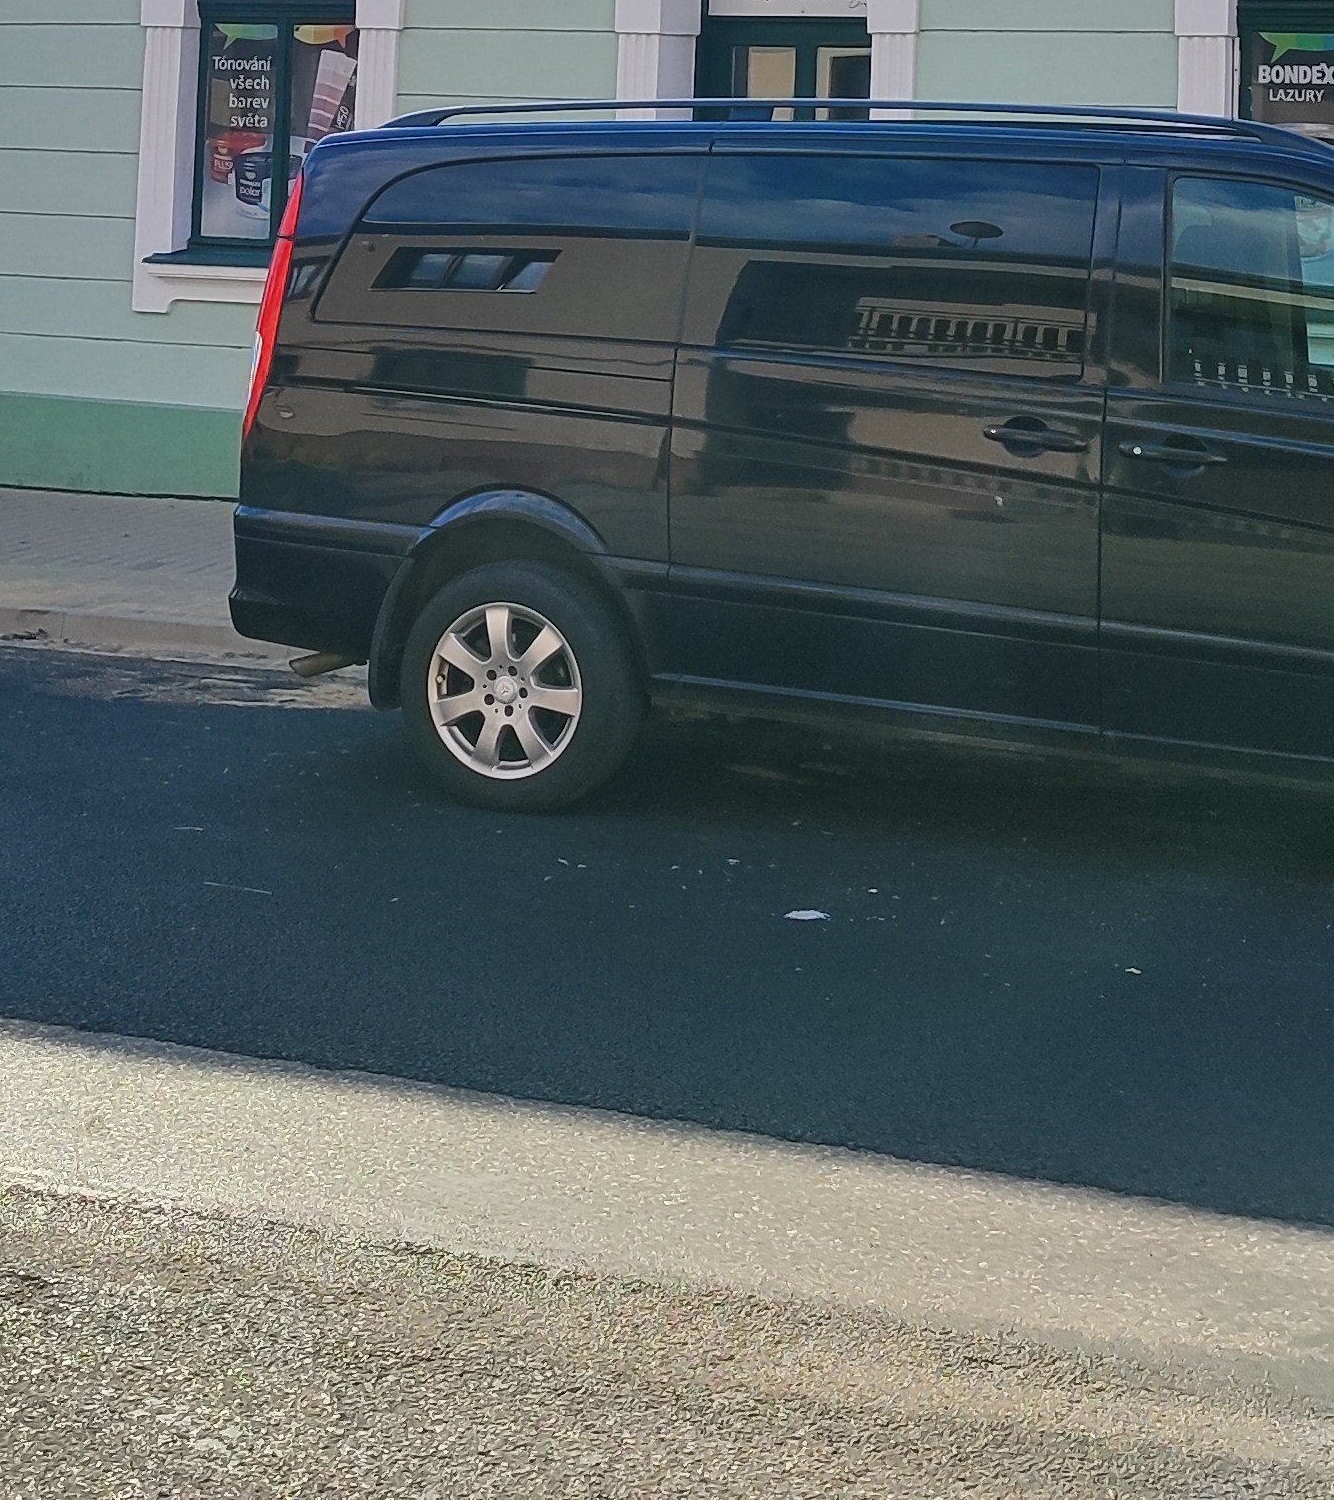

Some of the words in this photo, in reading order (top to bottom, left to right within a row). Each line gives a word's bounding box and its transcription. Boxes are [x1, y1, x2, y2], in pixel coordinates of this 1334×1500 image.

[212, 55, 273, 72] Tónování
[229, 74, 270, 90] všech
[228, 93, 270, 109] barev
[1269, 88, 1326, 104] LAZURY
[229, 113, 268, 128] světa
